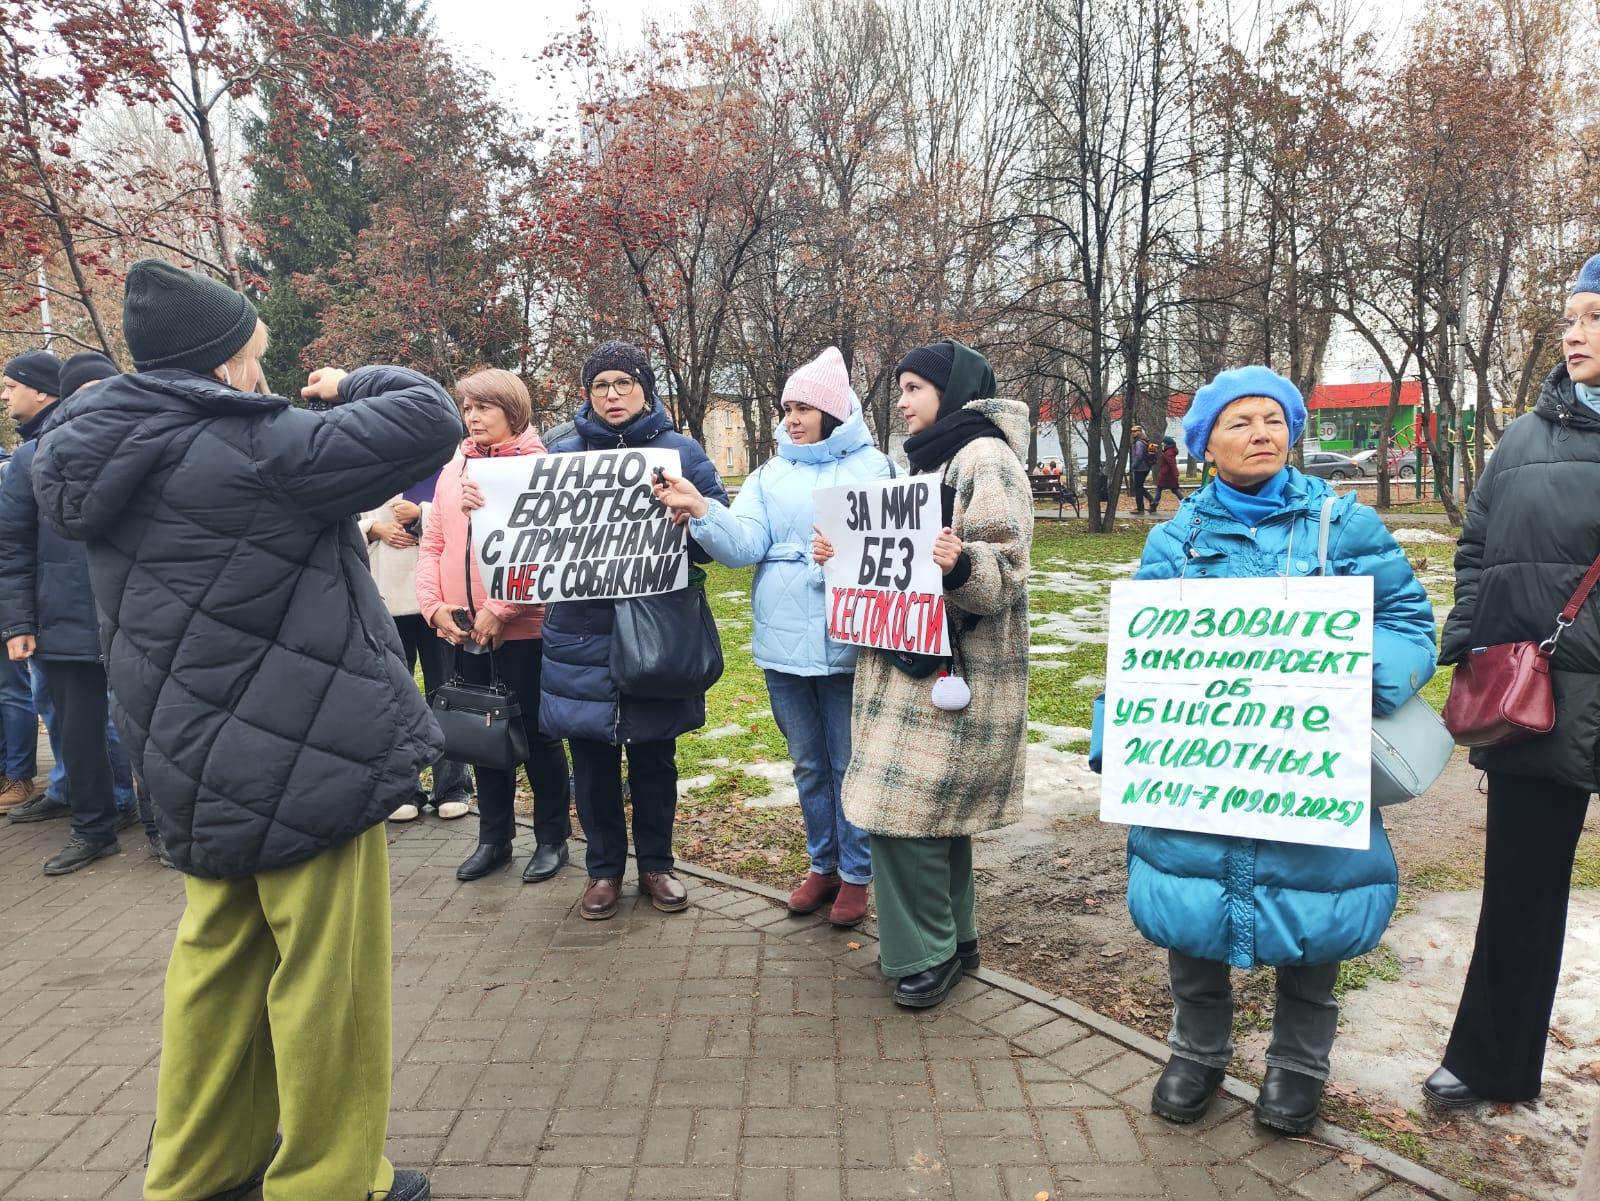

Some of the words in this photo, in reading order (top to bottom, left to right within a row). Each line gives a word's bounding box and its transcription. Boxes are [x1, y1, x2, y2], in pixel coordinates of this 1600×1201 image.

[528, 451, 646, 490] НАДО
[846, 490, 872, 531] ЗА
[881, 483, 928, 530] МИР
[481, 530, 505, 565] С
[509, 517, 688, 563] ПРИЧИНАМИ,
[858, 536, 914, 591] БЕЗ
[491, 566, 505, 600] А
[507, 564, 539, 601] НЕ
[537, 563, 555, 598] С
[560, 554, 683, 598] СОБАКАМИ
[828, 587, 945, 654] ЖЕСТОКОСТИ
